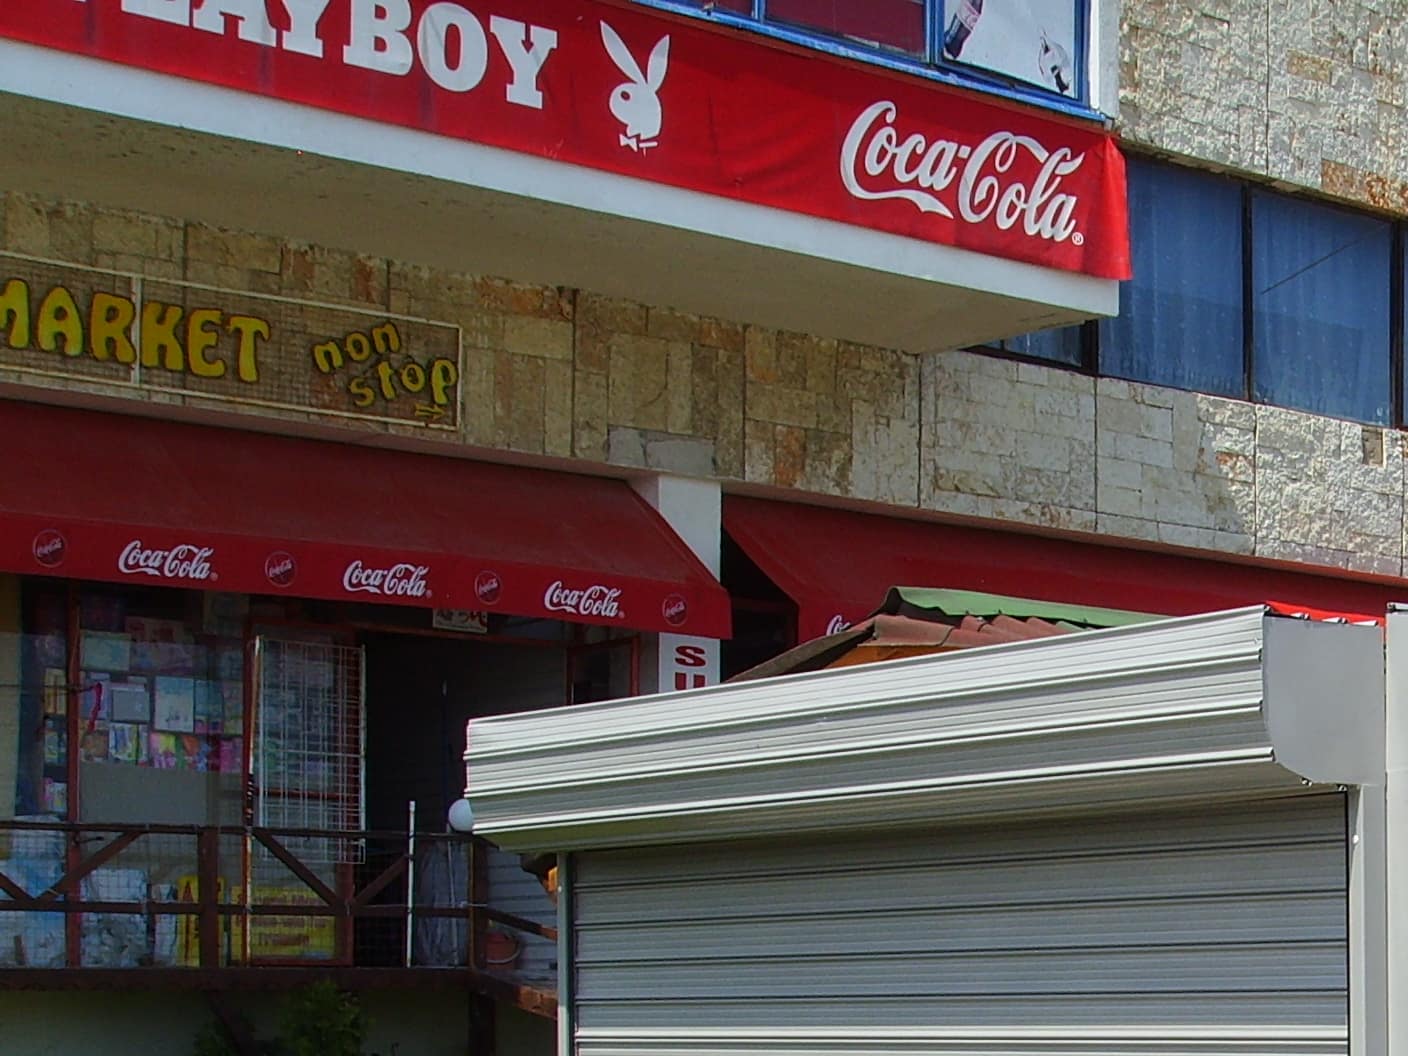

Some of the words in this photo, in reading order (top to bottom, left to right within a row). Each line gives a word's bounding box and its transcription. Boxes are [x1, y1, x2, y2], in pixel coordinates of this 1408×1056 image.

[72, 0, 557, 109] AYBOY
[840, 100, 1085, 242] Coca-Cola
[313, 321, 399, 373] non
[348, 357, 457, 407] stop
[119, 541, 213, 579] Coca-Cola
[344, 561, 429, 597] Coca-Cola
[545, 581, 621, 617] Coca-Cola
